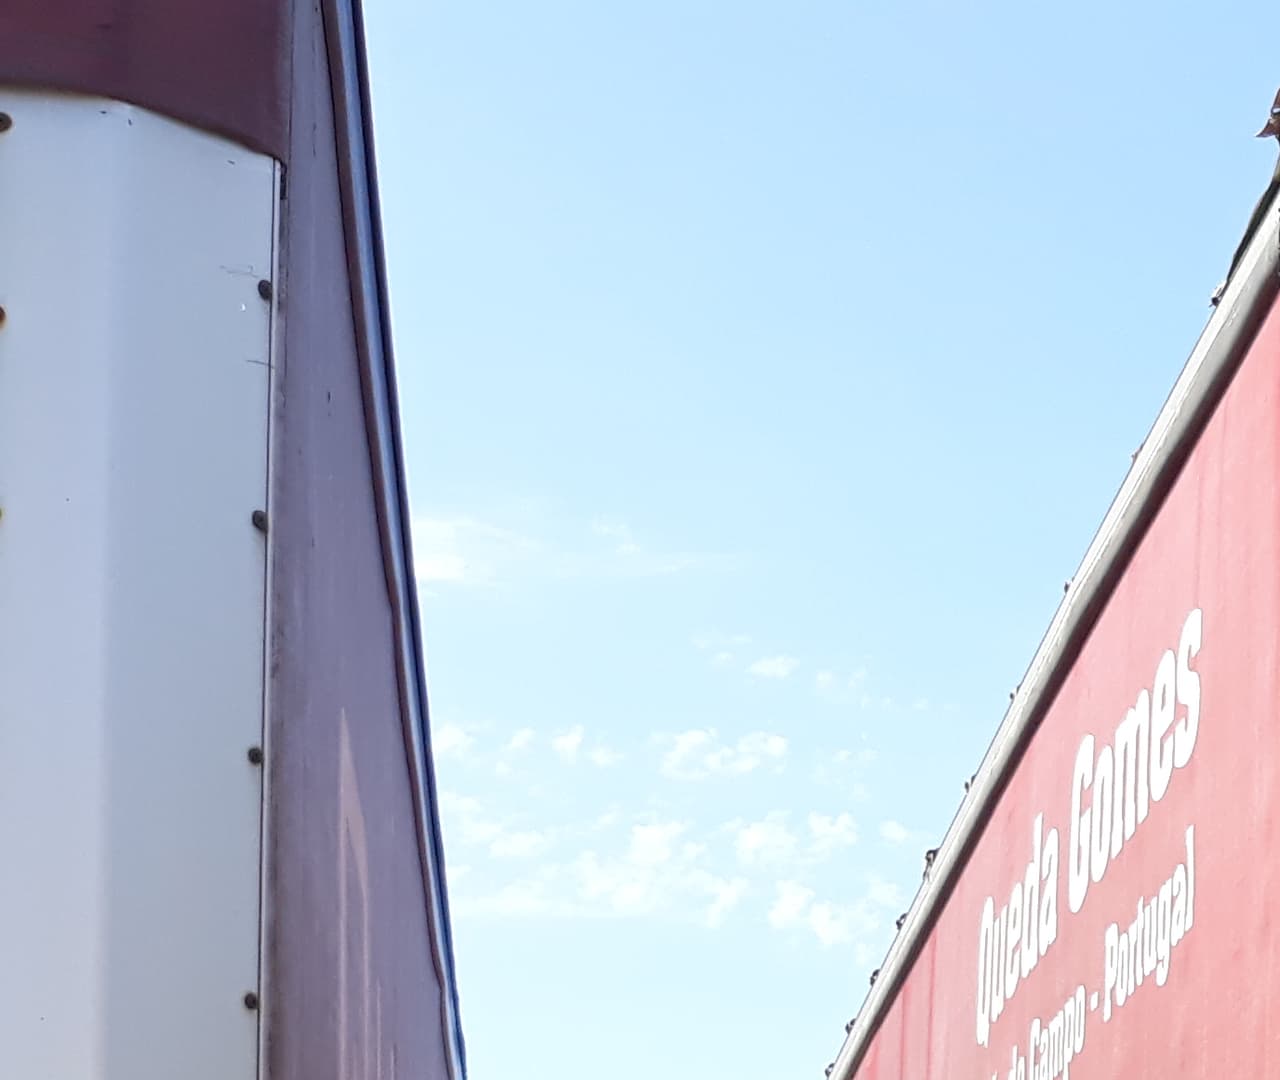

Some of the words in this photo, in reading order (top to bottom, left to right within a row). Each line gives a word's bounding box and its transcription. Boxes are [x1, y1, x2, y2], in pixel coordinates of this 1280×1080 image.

[975, 810, 1059, 1048] Queda
[1068, 607, 1202, 914] Gomes
[1103, 824, 1195, 1023] Portugal
